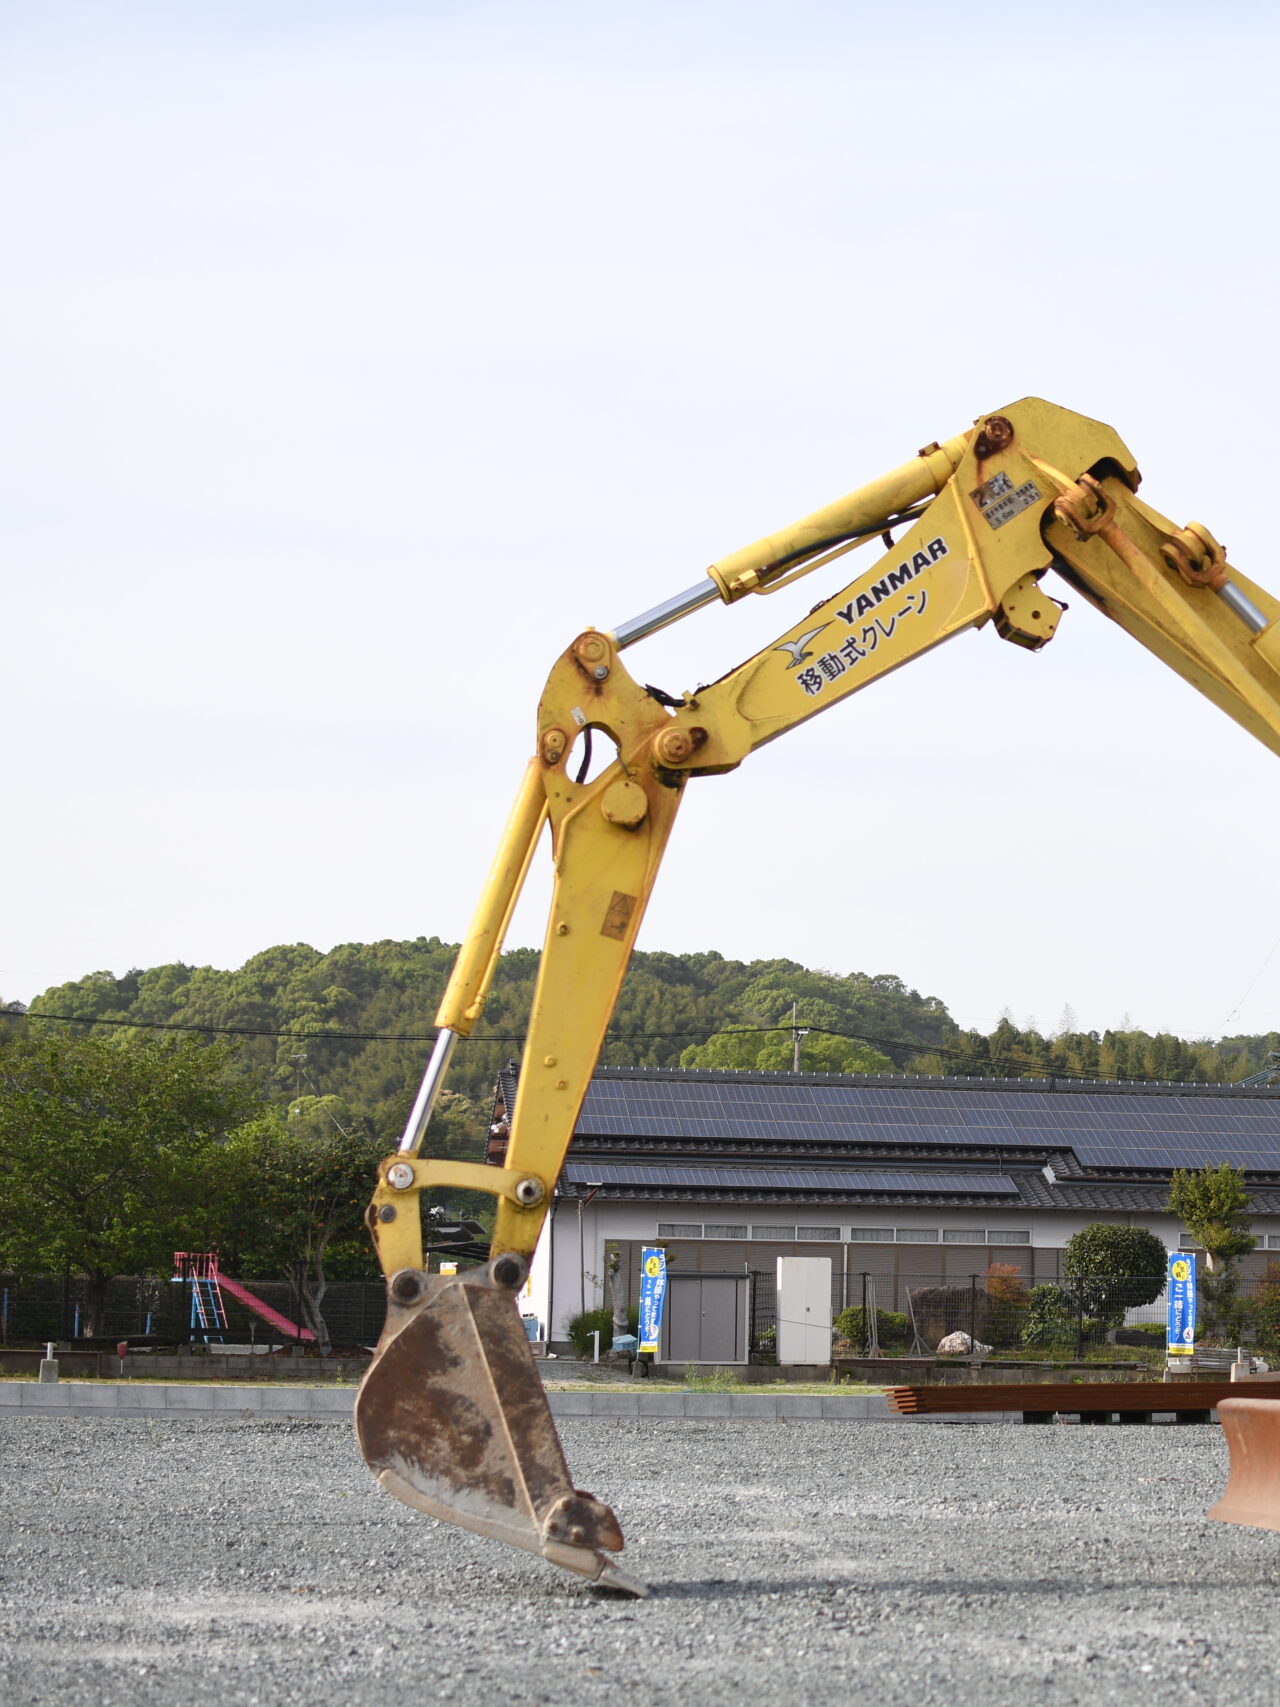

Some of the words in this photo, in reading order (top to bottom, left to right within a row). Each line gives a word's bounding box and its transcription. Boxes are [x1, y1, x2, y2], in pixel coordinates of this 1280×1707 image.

[836, 537, 948, 625] YANMAR
[797, 590, 926, 695] 移動式クレーン
